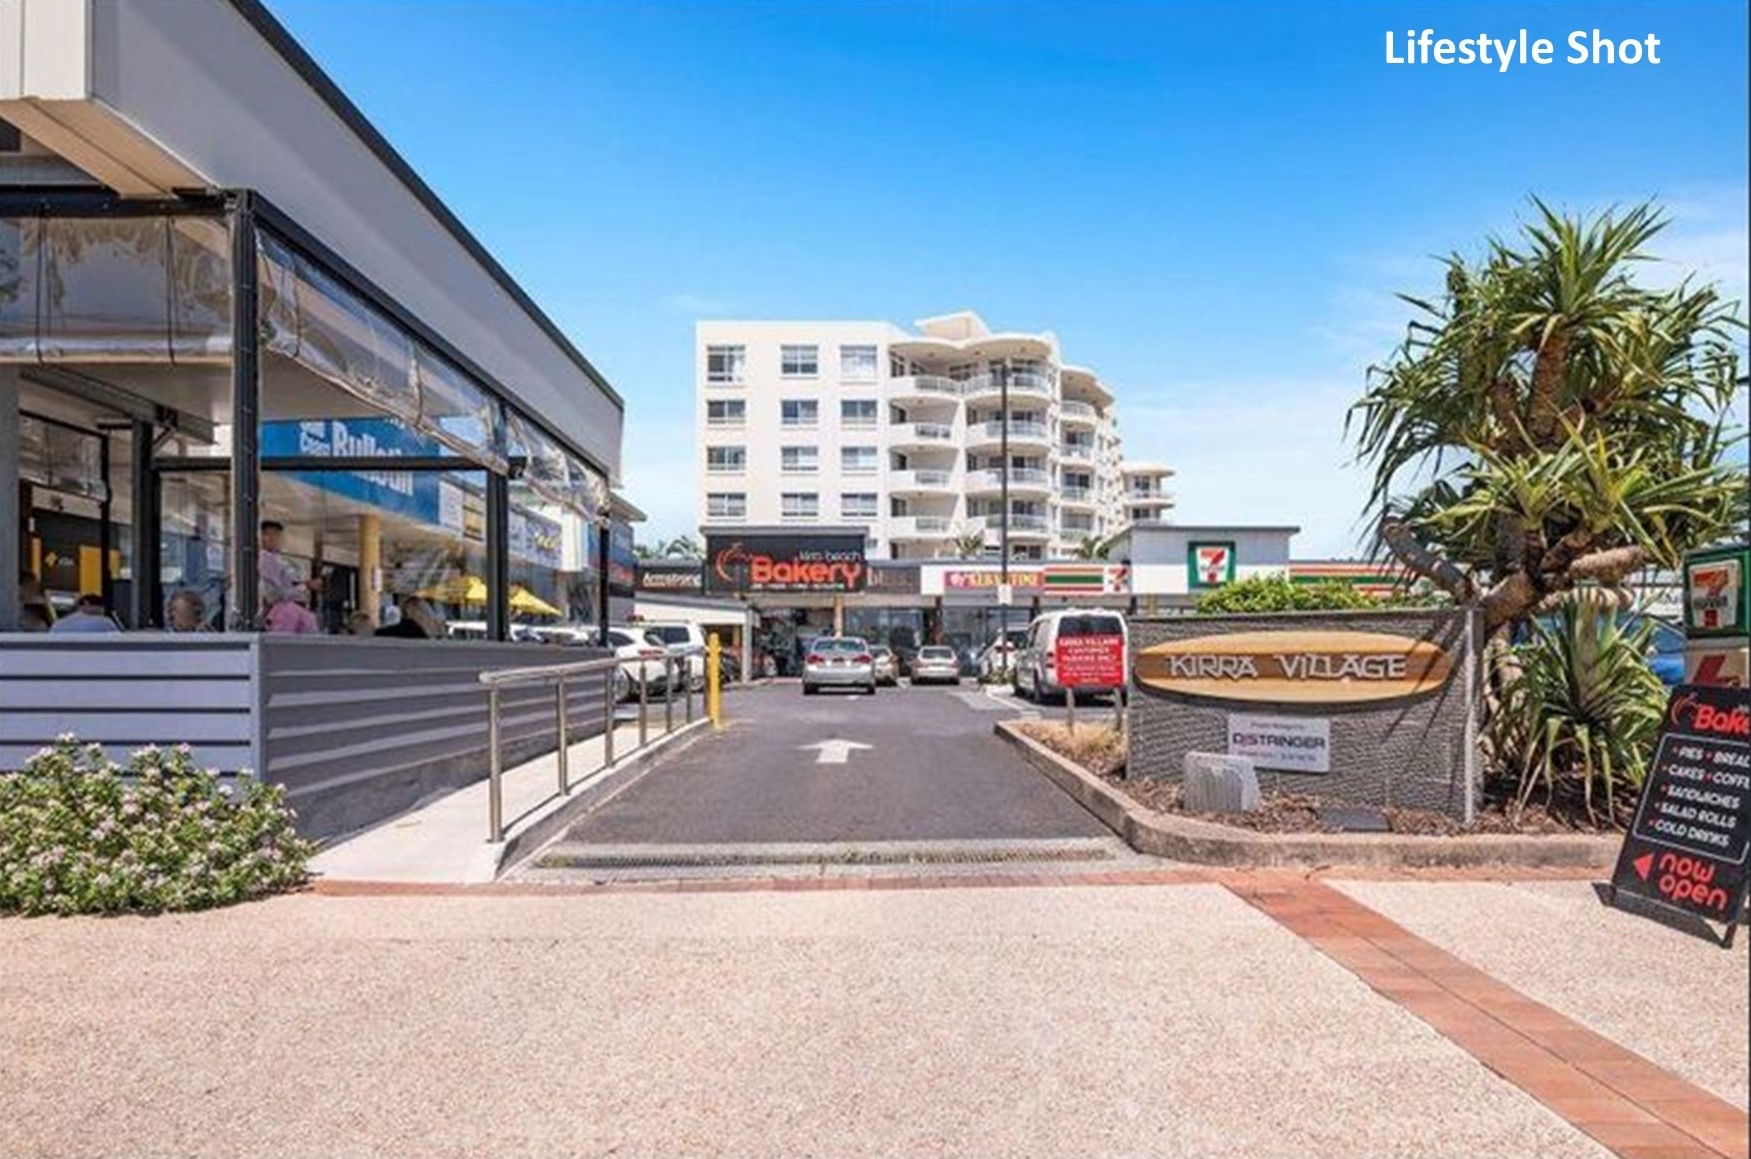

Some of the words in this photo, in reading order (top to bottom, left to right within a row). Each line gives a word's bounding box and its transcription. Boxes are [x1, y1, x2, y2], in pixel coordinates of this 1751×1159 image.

[751, 554, 862, 589] Bakery
[1170, 653, 1259, 678] KIRRA
[1273, 653, 1407, 679] VILLAGE
[1668, 763, 1705, 781] CAKES
[1667, 784, 1740, 810] SANDWICHES
[1660, 801, 1698, 820] SALAD
[1698, 808, 1738, 829] ROLLS
[1654, 818, 1687, 837] COLD
[1687, 825, 1730, 848] DRINKS
[1658, 852, 1716, 883] now
[1658, 873, 1729, 911] open
